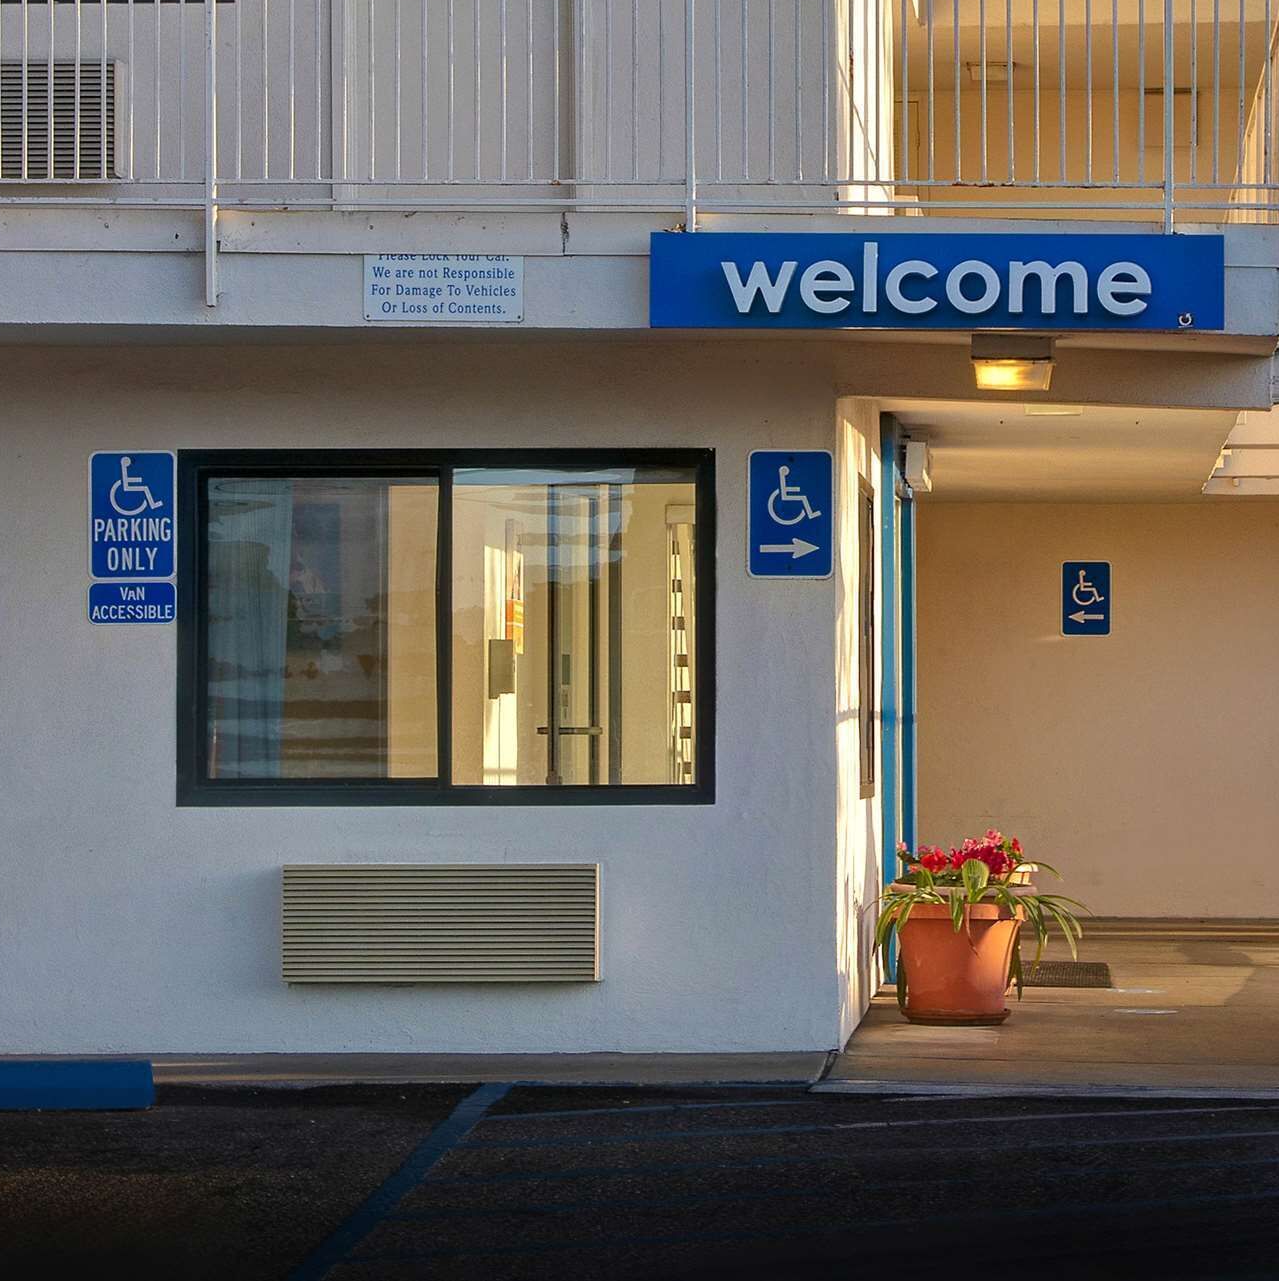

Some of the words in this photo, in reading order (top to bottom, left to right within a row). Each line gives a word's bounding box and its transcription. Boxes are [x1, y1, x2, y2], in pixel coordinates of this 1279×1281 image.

[372, 266, 391, 279] We
[395, 269, 414, 279] are
[419, 268, 438, 279] not
[443, 266, 515, 281] Responsible
[721, 241, 1152, 315] welcome
[371, 283, 391, 296] For
[395, 283, 442, 298] Damage
[447, 284, 462, 297] To
[466, 284, 517, 297] Vehicles
[381, 301, 397, 314] Or
[402, 301, 428, 314] Loss
[432, 301, 445, 314] of
[448, 302, 507, 314] Contents.
[94, 518, 171, 542] PARKING
[107, 547, 158, 571] ONLY
[120, 586, 145, 601] VAN
[92, 604, 172, 620] ACCESSIBLE
